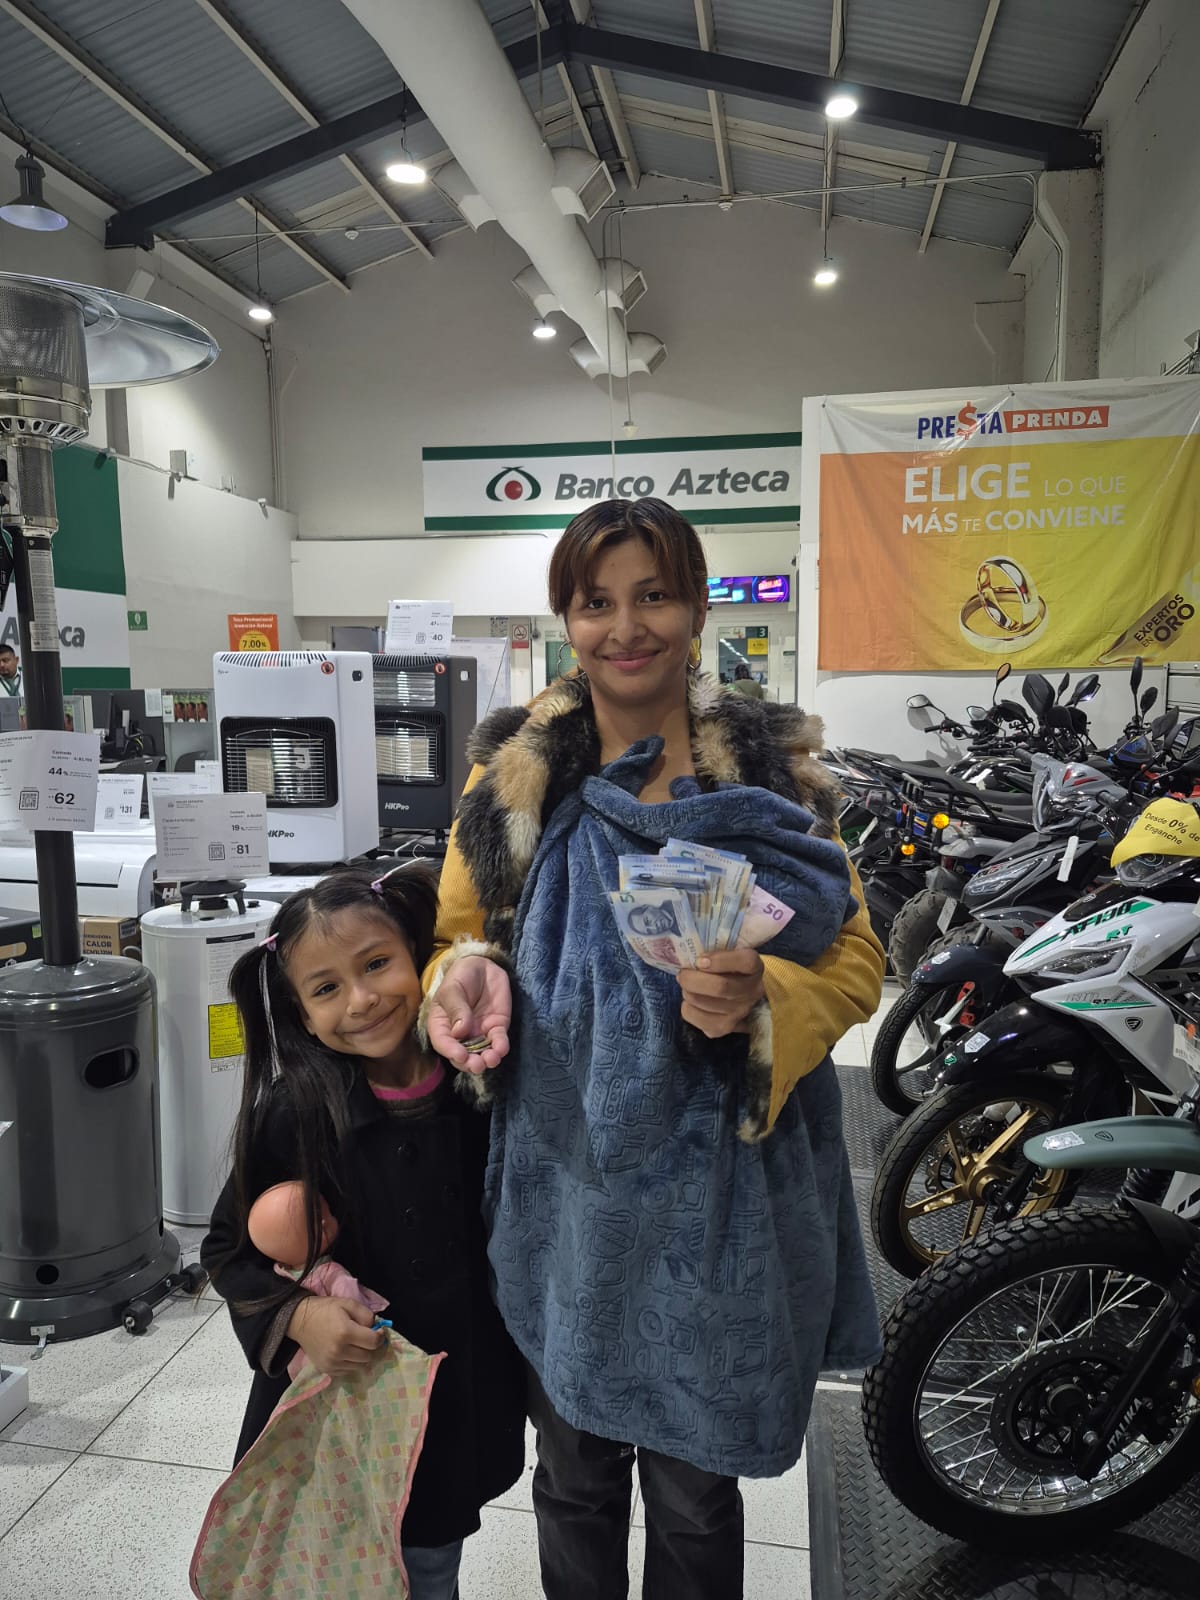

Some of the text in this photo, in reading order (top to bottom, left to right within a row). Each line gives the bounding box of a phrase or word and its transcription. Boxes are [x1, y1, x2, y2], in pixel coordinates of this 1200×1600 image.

[917, 401, 1103, 440] PRE$TA PRENDA
[555, 467, 790, 500] Banco Azteca
[904, 462, 1127, 504] ELIGE LO QUE
[902, 505, 1126, 535] MÁS TE CONVIENE
[759, 627, 767, 637] 3
[1134, 593, 1185, 642] EXPERTOS
[1140, 603, 1195, 648] EN ORO
[1144, 812, 1200, 842] Desde 0% de
[762, 902, 784, 921] 50
[86, 940, 112, 948] CALOR
[1106, 1397, 1143, 1453] ITALIKA
